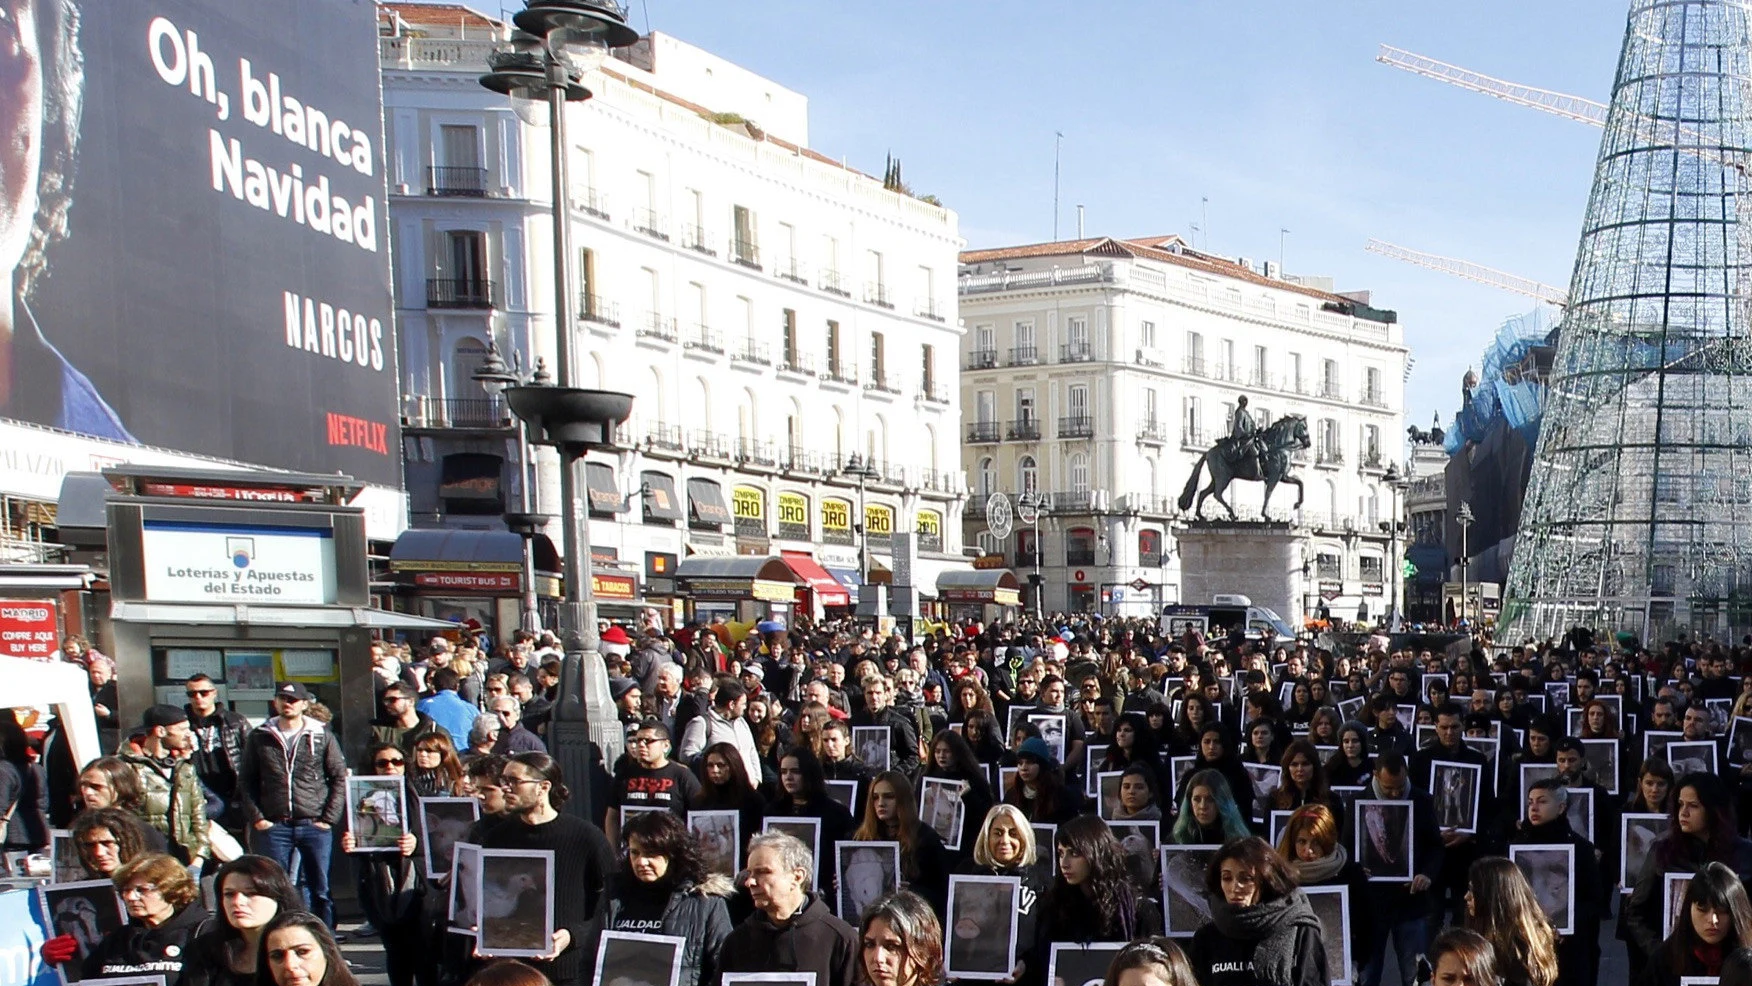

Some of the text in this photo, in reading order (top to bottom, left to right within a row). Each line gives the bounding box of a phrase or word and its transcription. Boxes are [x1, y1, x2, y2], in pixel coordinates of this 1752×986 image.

[148, 16, 373, 176] Oh, blanca
[210, 128, 377, 252] Navidad
[283, 290, 384, 371] NARCOS
[326, 412, 388, 455] NETFLIX
[734, 491, 761, 500] OMPRO
[779, 496, 804, 506] OMPRO
[733, 499, 760, 517] ORO
[779, 505, 804, 522] ORO
[822, 502, 847, 511] OMPRO
[866, 508, 889, 517] OMPRO
[821, 511, 847, 527] ORO
[865, 515, 889, 531] ORO
[167, 566, 314, 582] Loterías y Apuestas
[440, 577, 477, 585] TOURIST
[478, 577, 496, 585] BUS
[204, 582, 282, 595] del Estado
[601, 578, 631, 592] TABACOS
[2, 631, 32, 640] COMPRE
[10, 643, 48, 652] BUY HERE
